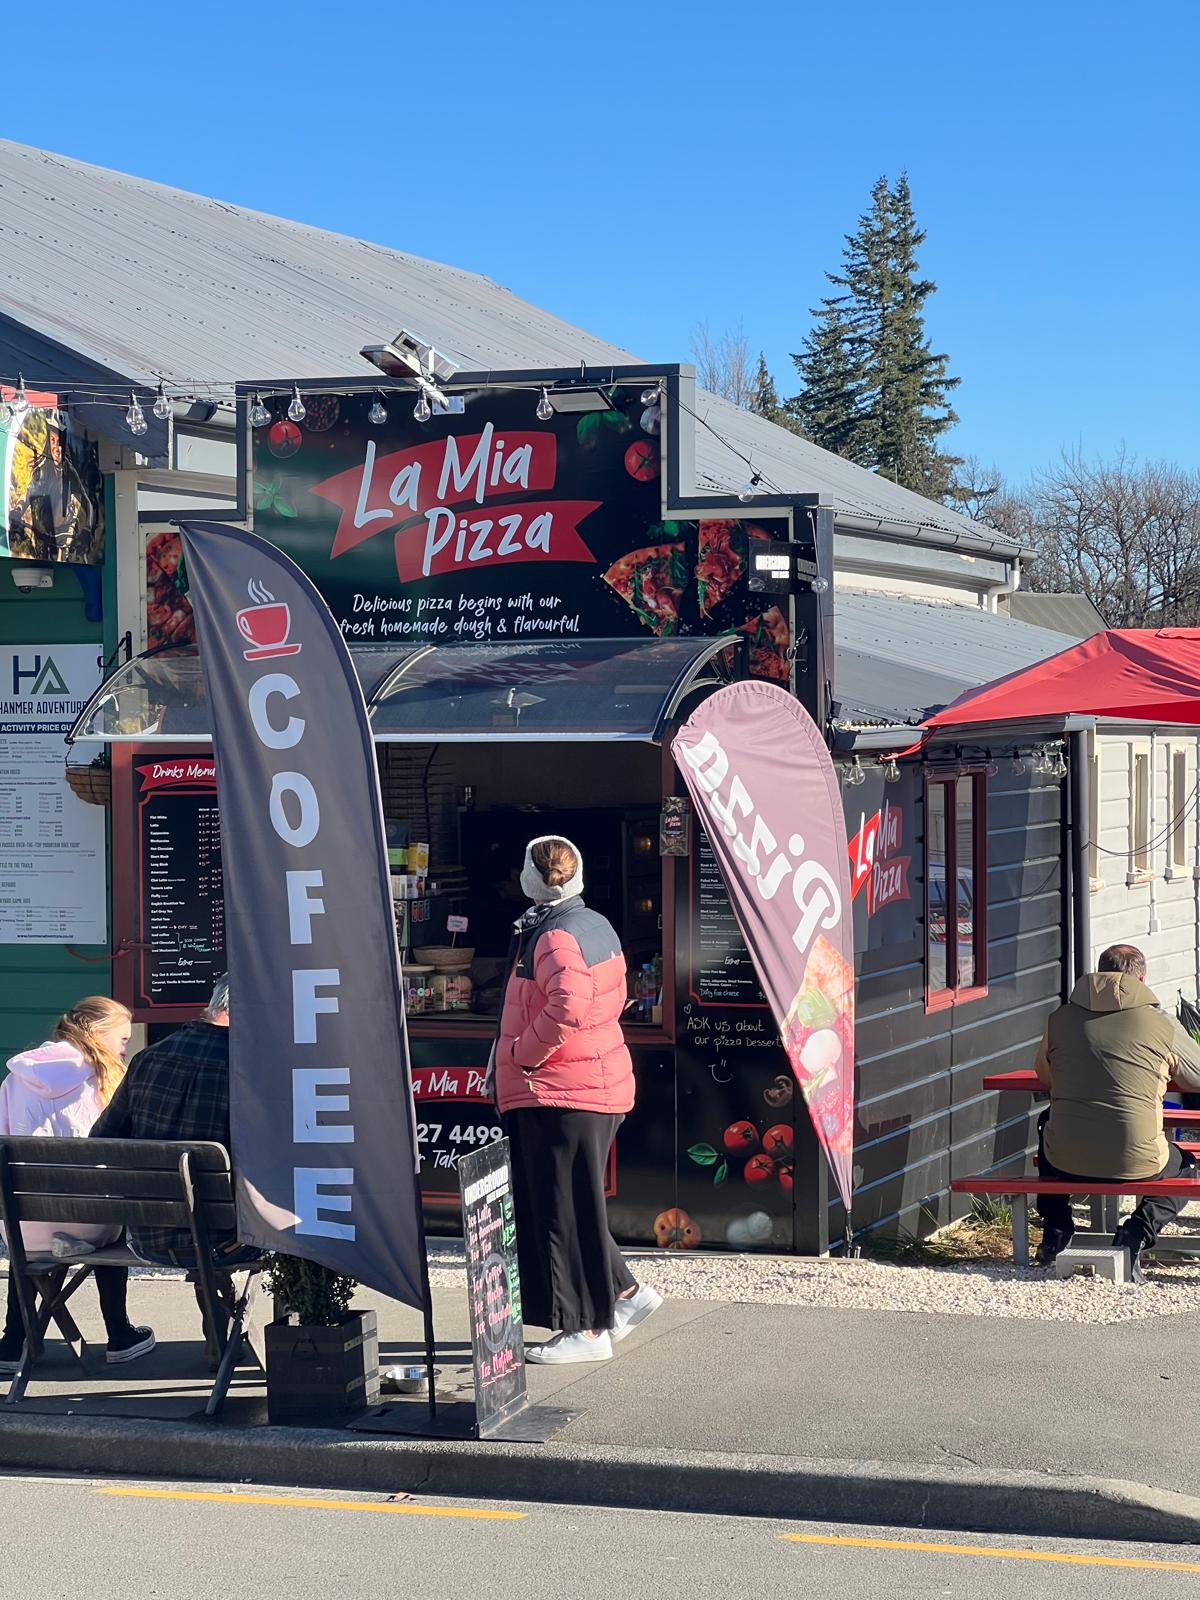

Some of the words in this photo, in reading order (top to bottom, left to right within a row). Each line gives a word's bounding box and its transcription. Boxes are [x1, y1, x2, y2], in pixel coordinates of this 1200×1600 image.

[353, 439, 422, 529] La
[436, 421, 533, 504] Mia
[422, 506, 553, 577] Pizza
[352, 593, 412, 613] Delicious
[416, 599, 452, 617] pizza
[458, 593, 502, 617] begins
[507, 592, 533, 612] with
[539, 596, 562, 609] our
[339, 617, 375, 636] fresh
[380, 616, 448, 635] homemade
[453, 615, 492, 639] dough
[496, 618, 507, 633] &
[1, 724, 36, 732] ACTIVITY
[37, 724, 60, 732] PRICE
[152, 759, 184, 778] Drinks
[186, 762, 215, 777] Menu
[857, 811, 875, 879] La
[876, 798, 897, 859] Mia
[872, 861, 902, 914] Pizza
[247, 672, 356, 1243] COFFEE
[687, 1016, 711, 1030] ASK
[714, 1021, 731, 1032] us
[735, 1019, 765, 1032] about
[694, 1036, 710, 1045] our
[713, 1035, 742, 1053] pizza
[412, 1079, 422, 1095] a
[428, 1069, 459, 1097] Mia
[466, 1070, 489, 1097] Piz
[432, 1148, 460, 1171] Tak
